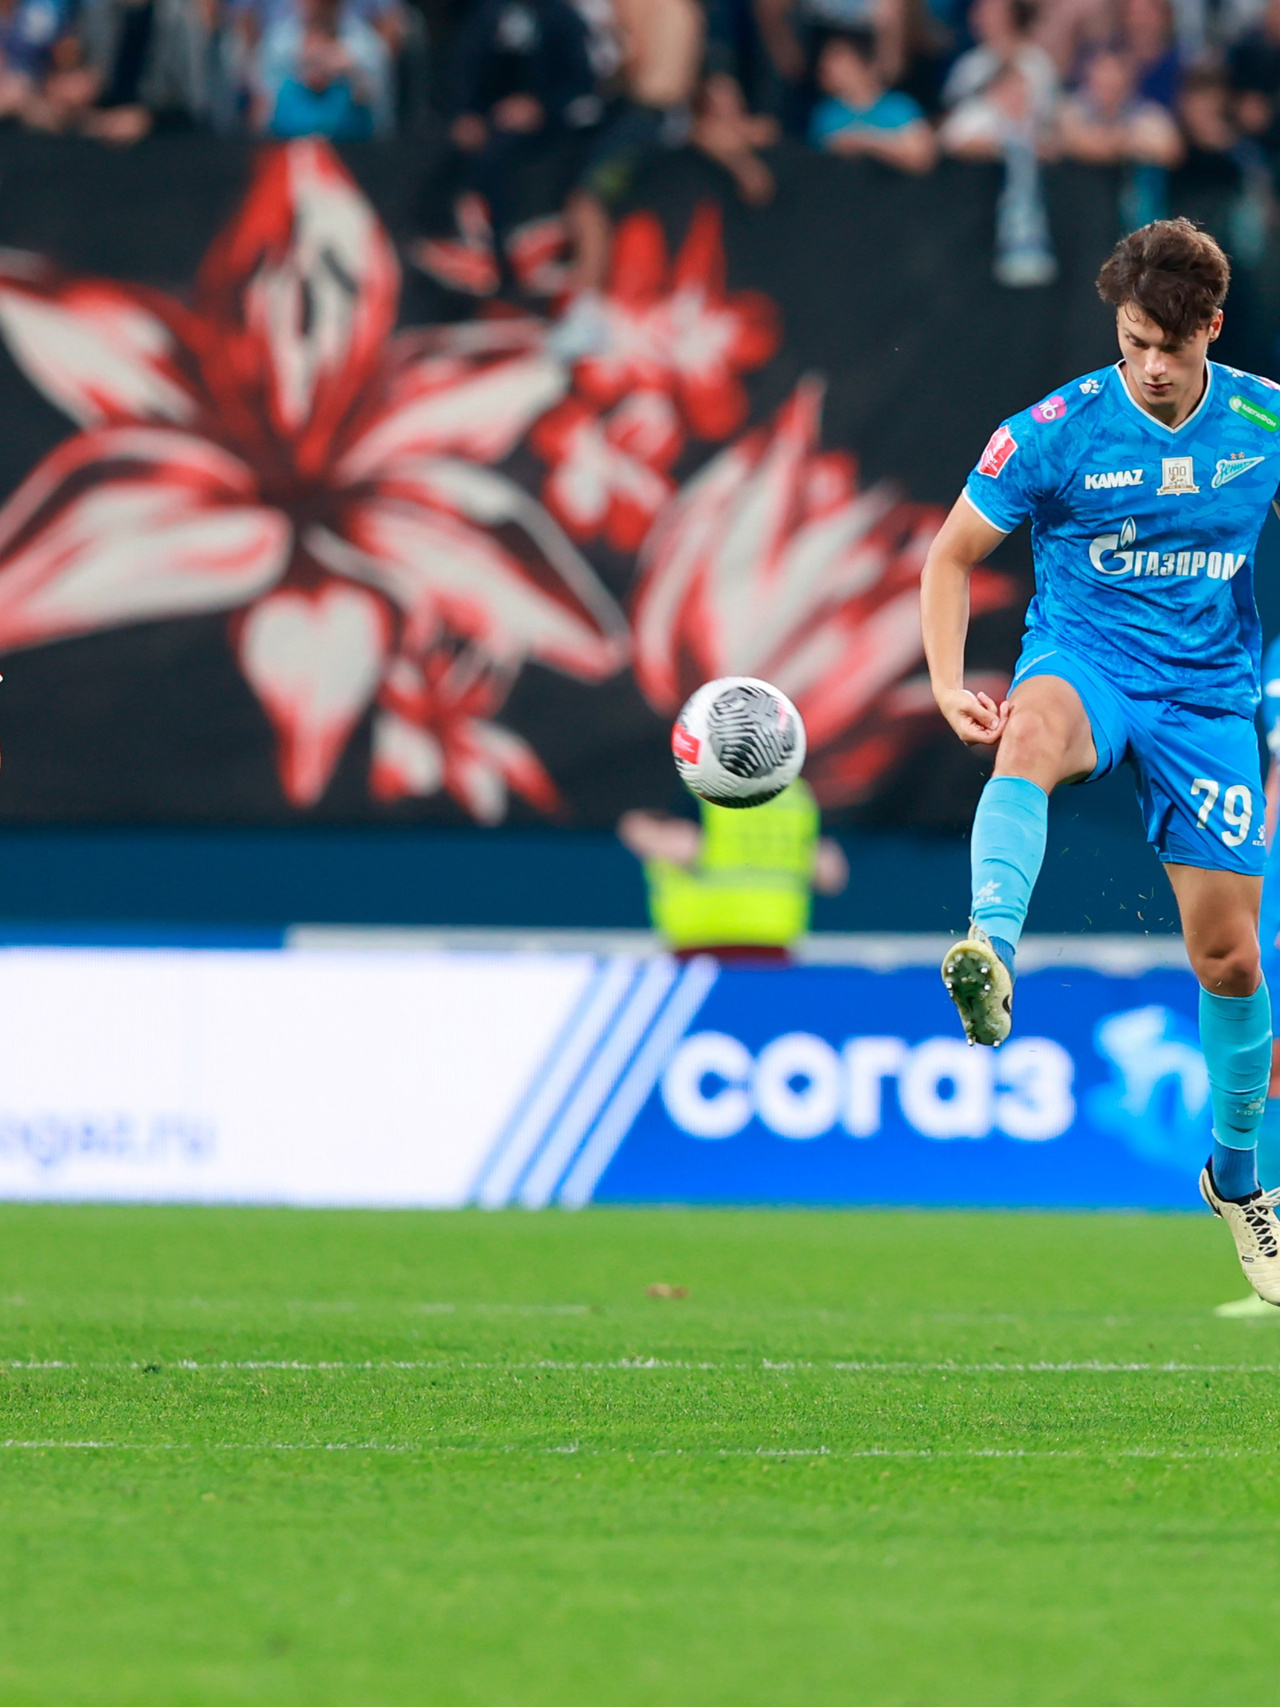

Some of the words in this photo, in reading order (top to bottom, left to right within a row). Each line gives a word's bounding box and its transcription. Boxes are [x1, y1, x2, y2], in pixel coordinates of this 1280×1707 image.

[1084, 469, 1144, 490] KAMAZ
[1134, 550, 1247, 581] ГАЗПРОМ
[1190, 777, 1253, 847] 79
[661, 1031, 1076, 1142] согаз
